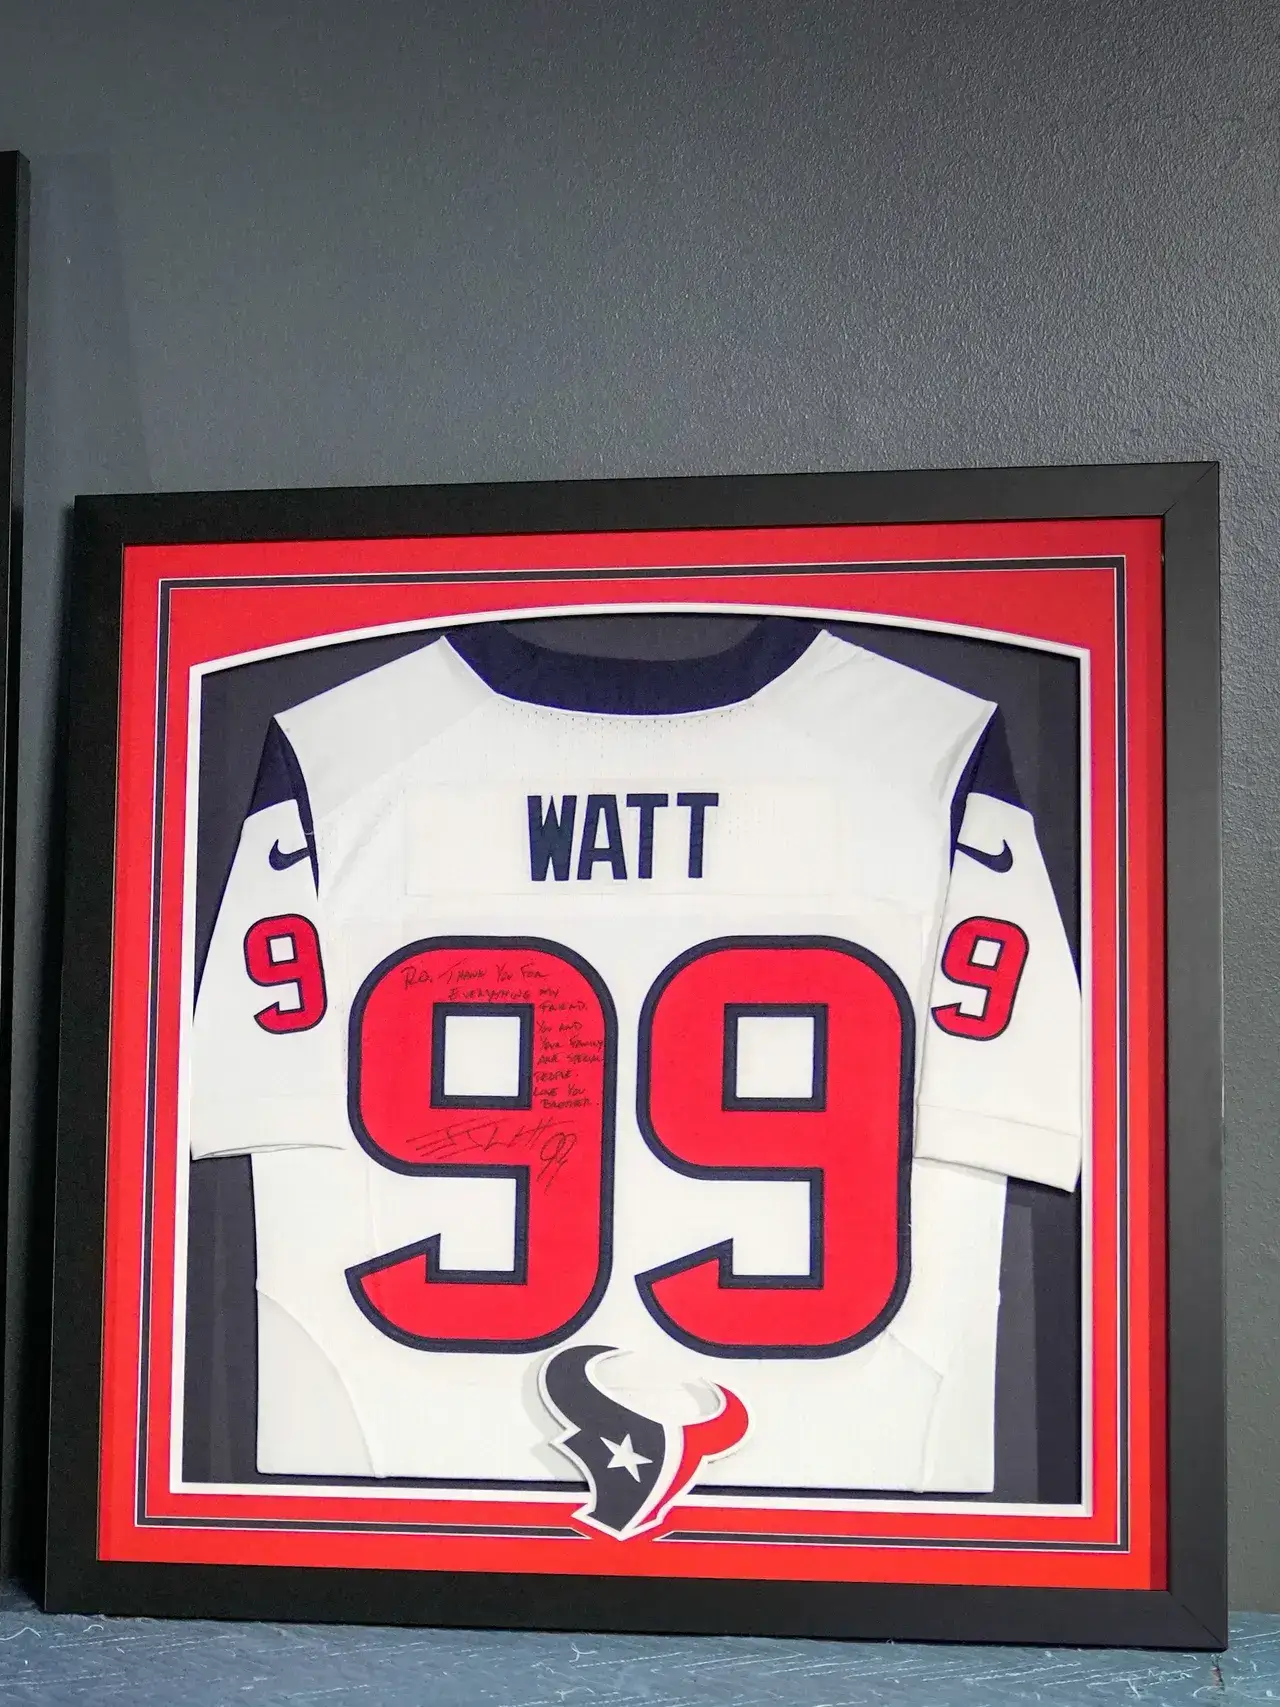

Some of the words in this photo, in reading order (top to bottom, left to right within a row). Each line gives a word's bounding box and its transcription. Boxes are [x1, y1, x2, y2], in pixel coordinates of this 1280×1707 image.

[527, 792, 719, 882] WATT
[243, 913, 328, 1035] 9
[930, 915, 1030, 1042] 9
[345, 935, 916, 1360] 99
